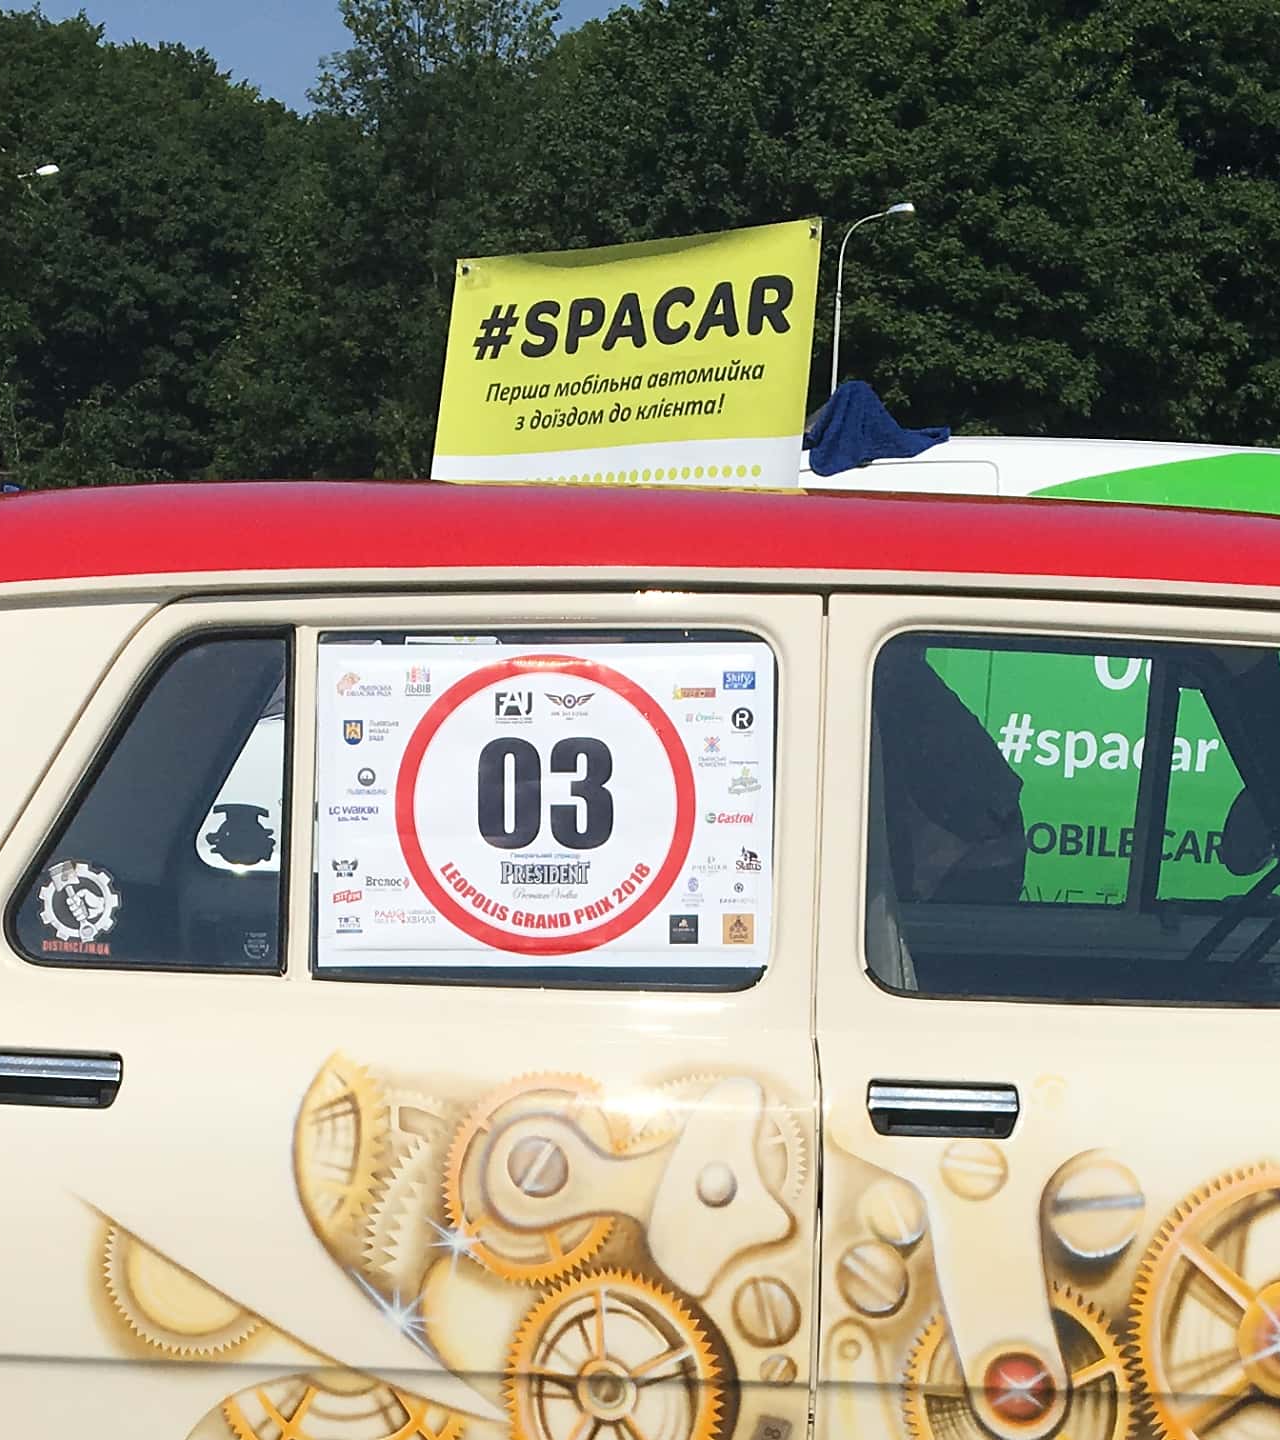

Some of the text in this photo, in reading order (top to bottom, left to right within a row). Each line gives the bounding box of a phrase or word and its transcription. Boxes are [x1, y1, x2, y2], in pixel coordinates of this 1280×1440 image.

[472, 274, 795, 361] #SPACAR
[484, 361, 765, 404] Перша мобільна автомийка
[514, 394, 726, 432] з доїздом до клієнта!
[477, 736, 613, 851] 03
[717, 812, 754, 824] Castrol
[501, 861, 591, 885] PRESIDENT
[439, 861, 652, 929] LEOPOLIS GRAND PRIX 2018
